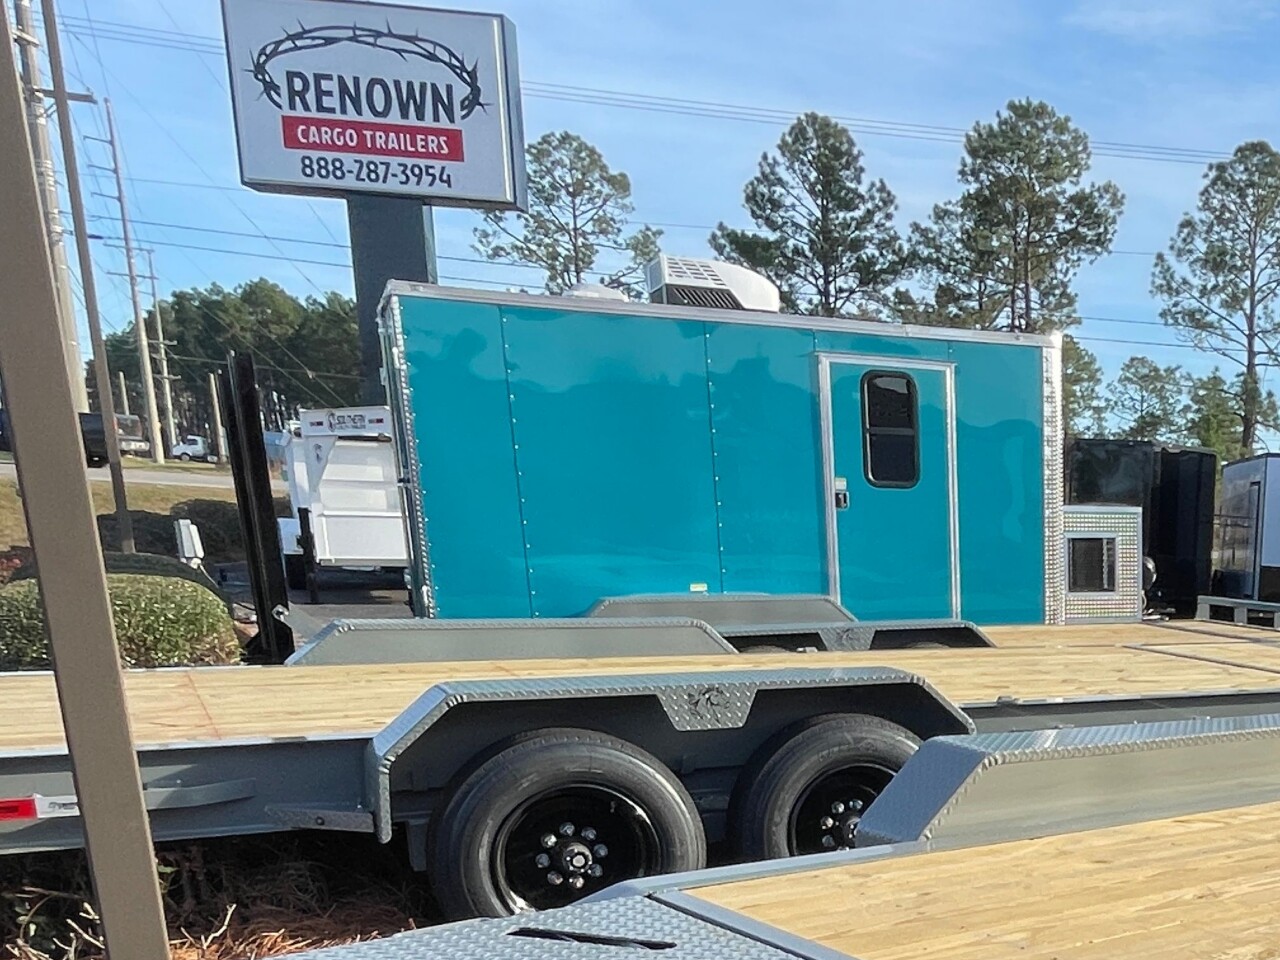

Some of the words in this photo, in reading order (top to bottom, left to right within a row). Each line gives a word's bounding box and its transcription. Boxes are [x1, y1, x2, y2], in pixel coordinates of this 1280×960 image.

[286, 70, 455, 124] RENOWN
[297, 125, 358, 148] CARGO
[362, 130, 449, 154] TRAILERS
[301, 155, 452, 188] 888-287-3954
